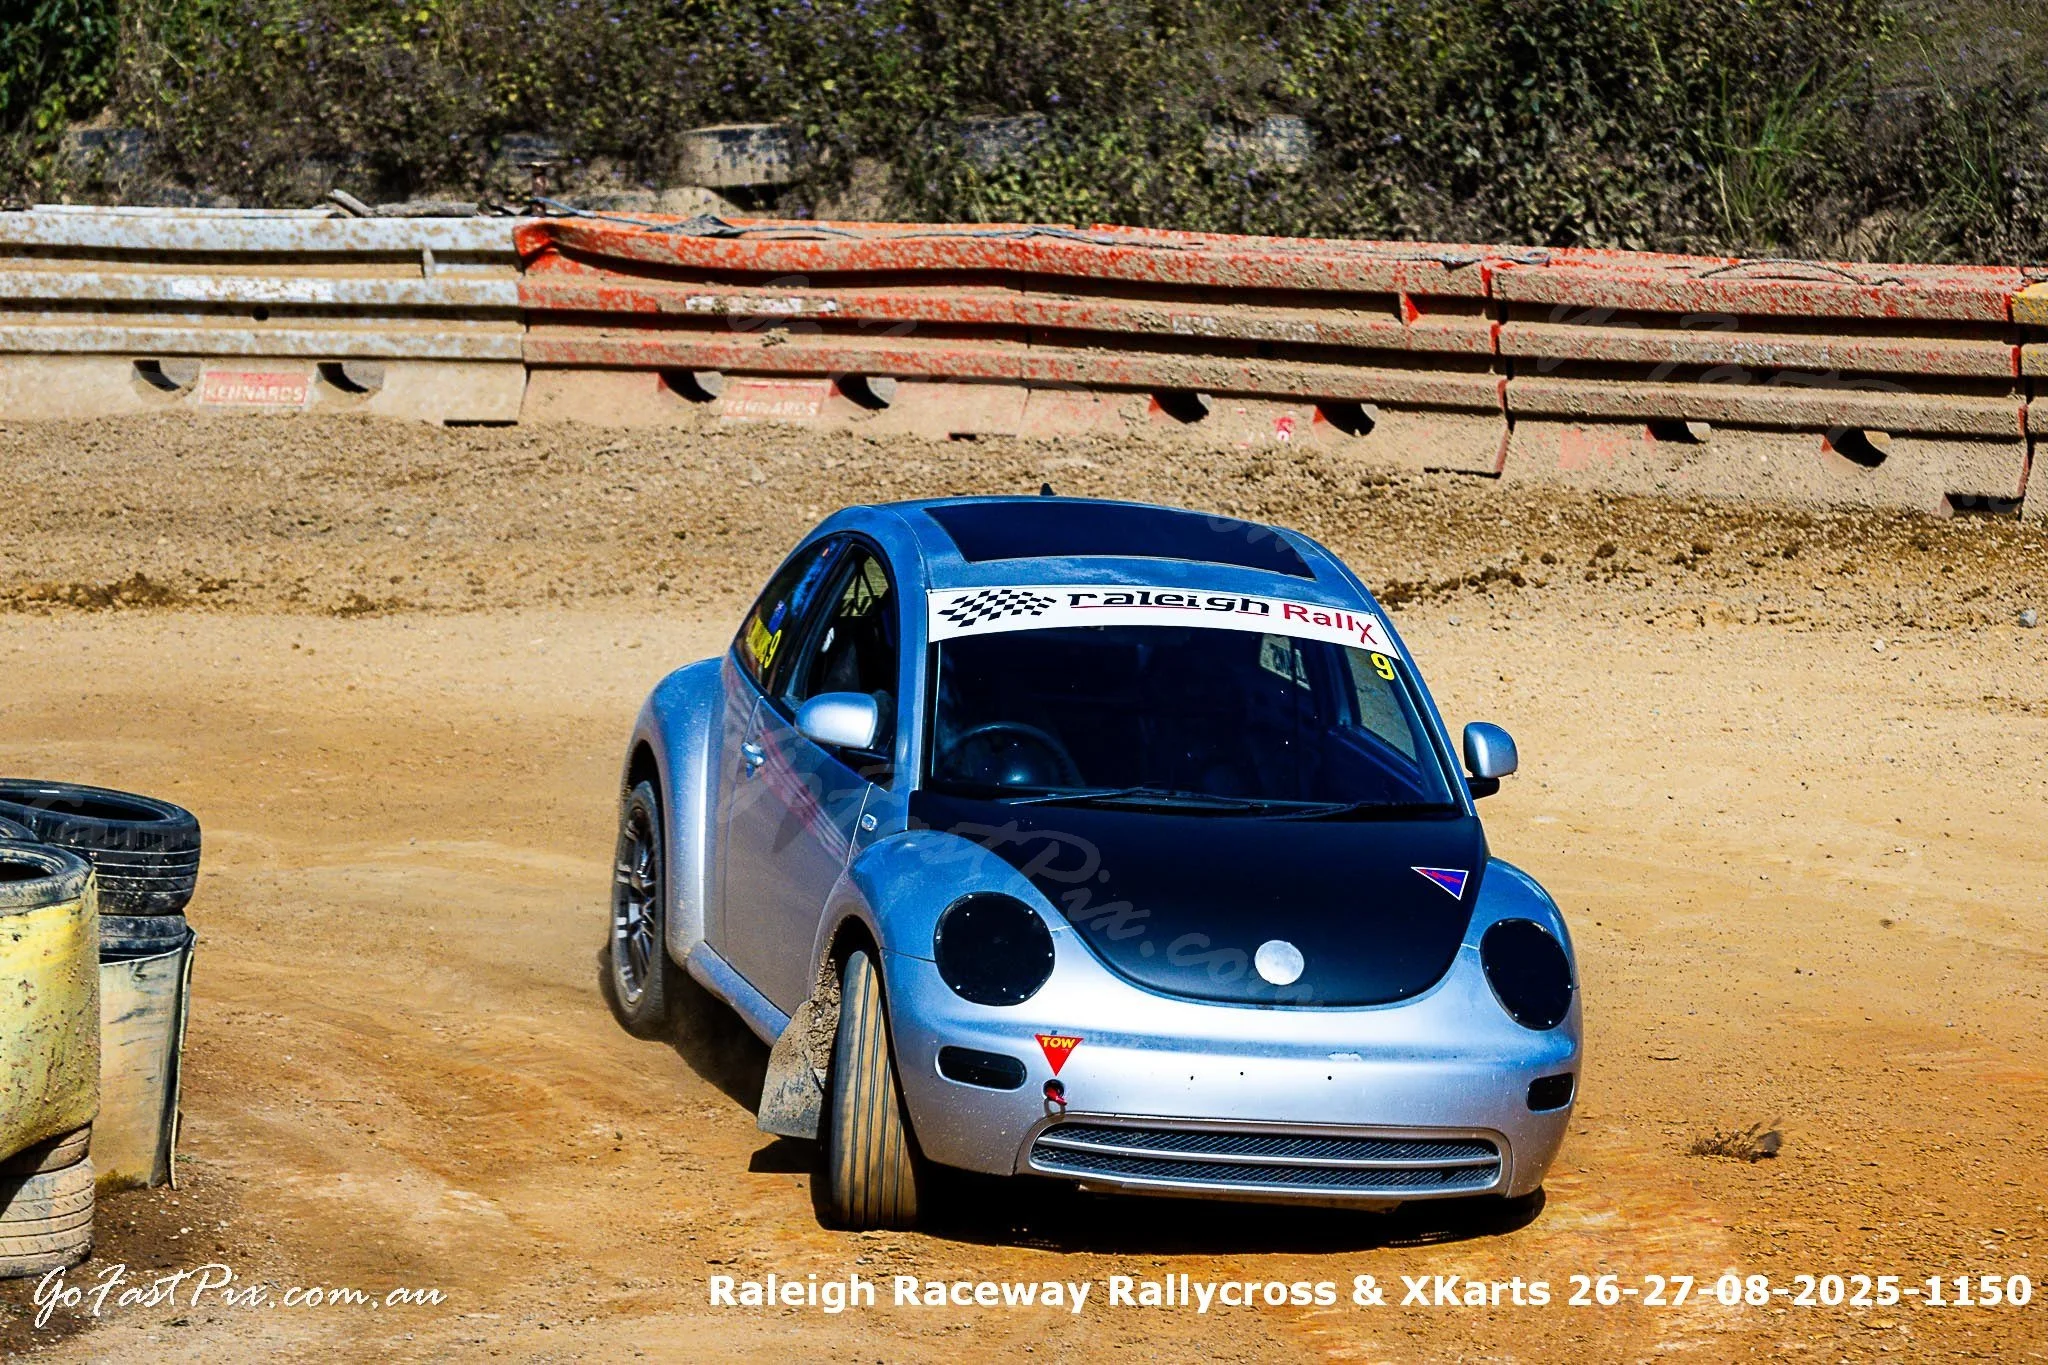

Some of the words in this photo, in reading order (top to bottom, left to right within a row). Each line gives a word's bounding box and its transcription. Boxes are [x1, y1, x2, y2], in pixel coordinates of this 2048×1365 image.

[204, 384, 304, 402] KENNARDS
[1065, 590, 1270, 616] raleigh
[764, 629, 782, 669] 9
[1370, 652, 1395, 681] 9
[1042, 1036, 1075, 1049] TOW
